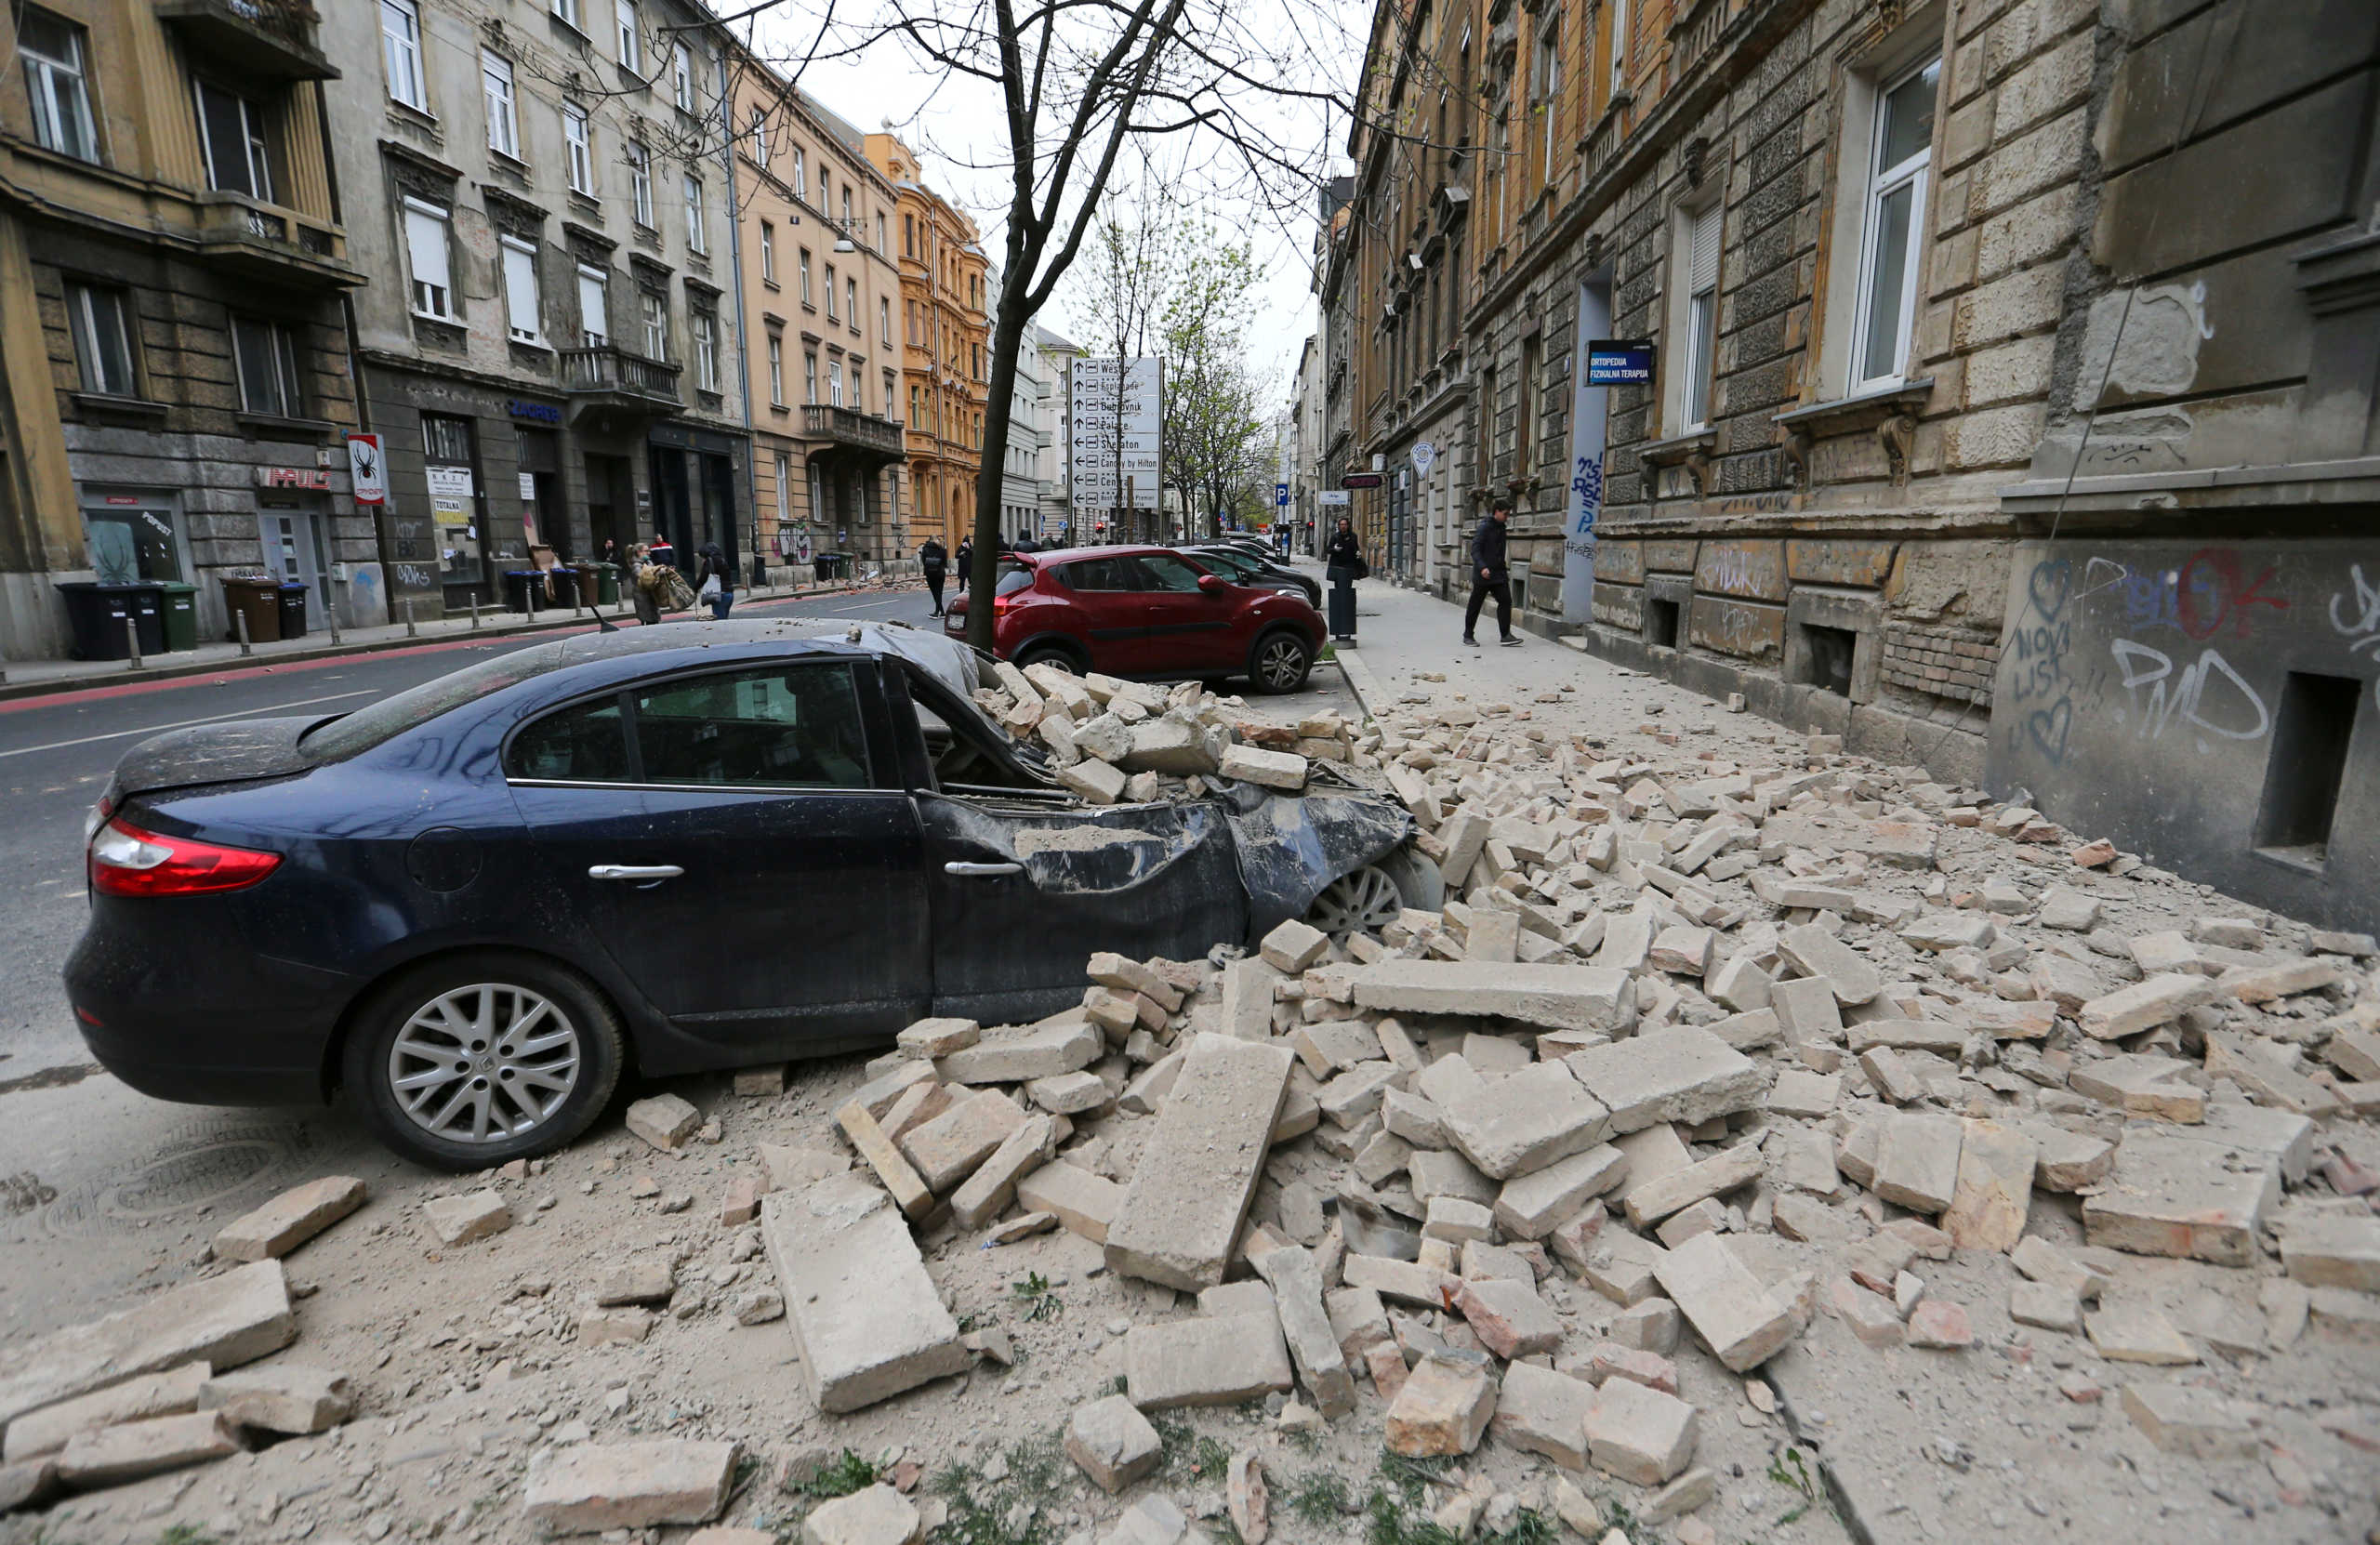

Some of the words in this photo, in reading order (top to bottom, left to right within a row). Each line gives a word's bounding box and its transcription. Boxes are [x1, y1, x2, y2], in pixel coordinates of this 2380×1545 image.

[1590, 369, 1620, 378] FIZIKALNA
[1101, 439, 1139, 449] Sheaton
[1127, 459, 1135, 469] by
[1137, 459, 1157, 468] Hilton
[1277, 489, 1287, 502] P
